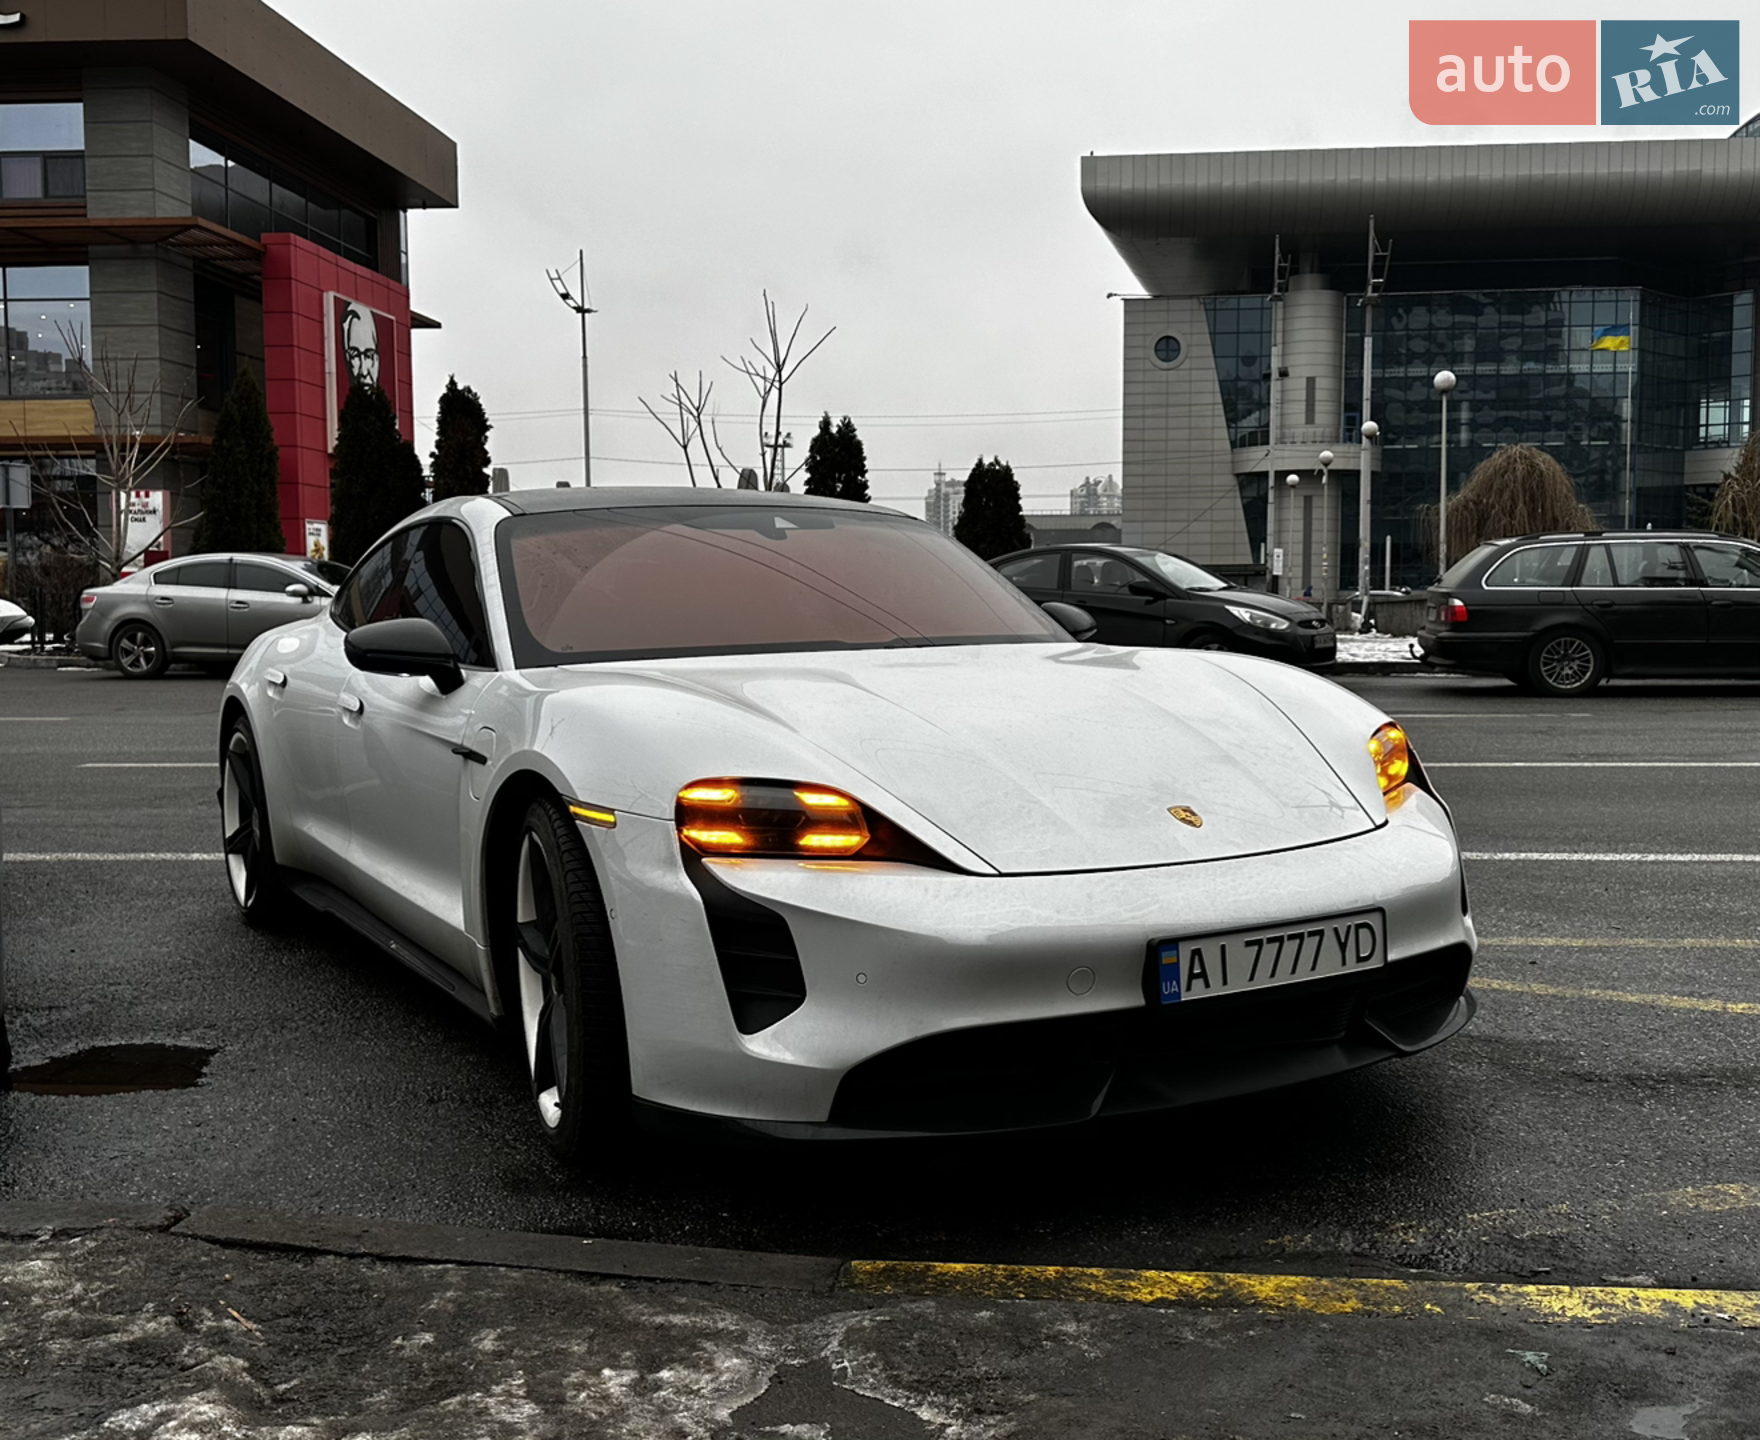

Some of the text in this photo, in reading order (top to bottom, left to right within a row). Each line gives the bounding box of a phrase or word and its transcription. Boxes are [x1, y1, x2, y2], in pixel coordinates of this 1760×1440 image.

[1185, 920, 1377, 992] AI 7777 YD
[1162, 980, 1180, 995] UA
